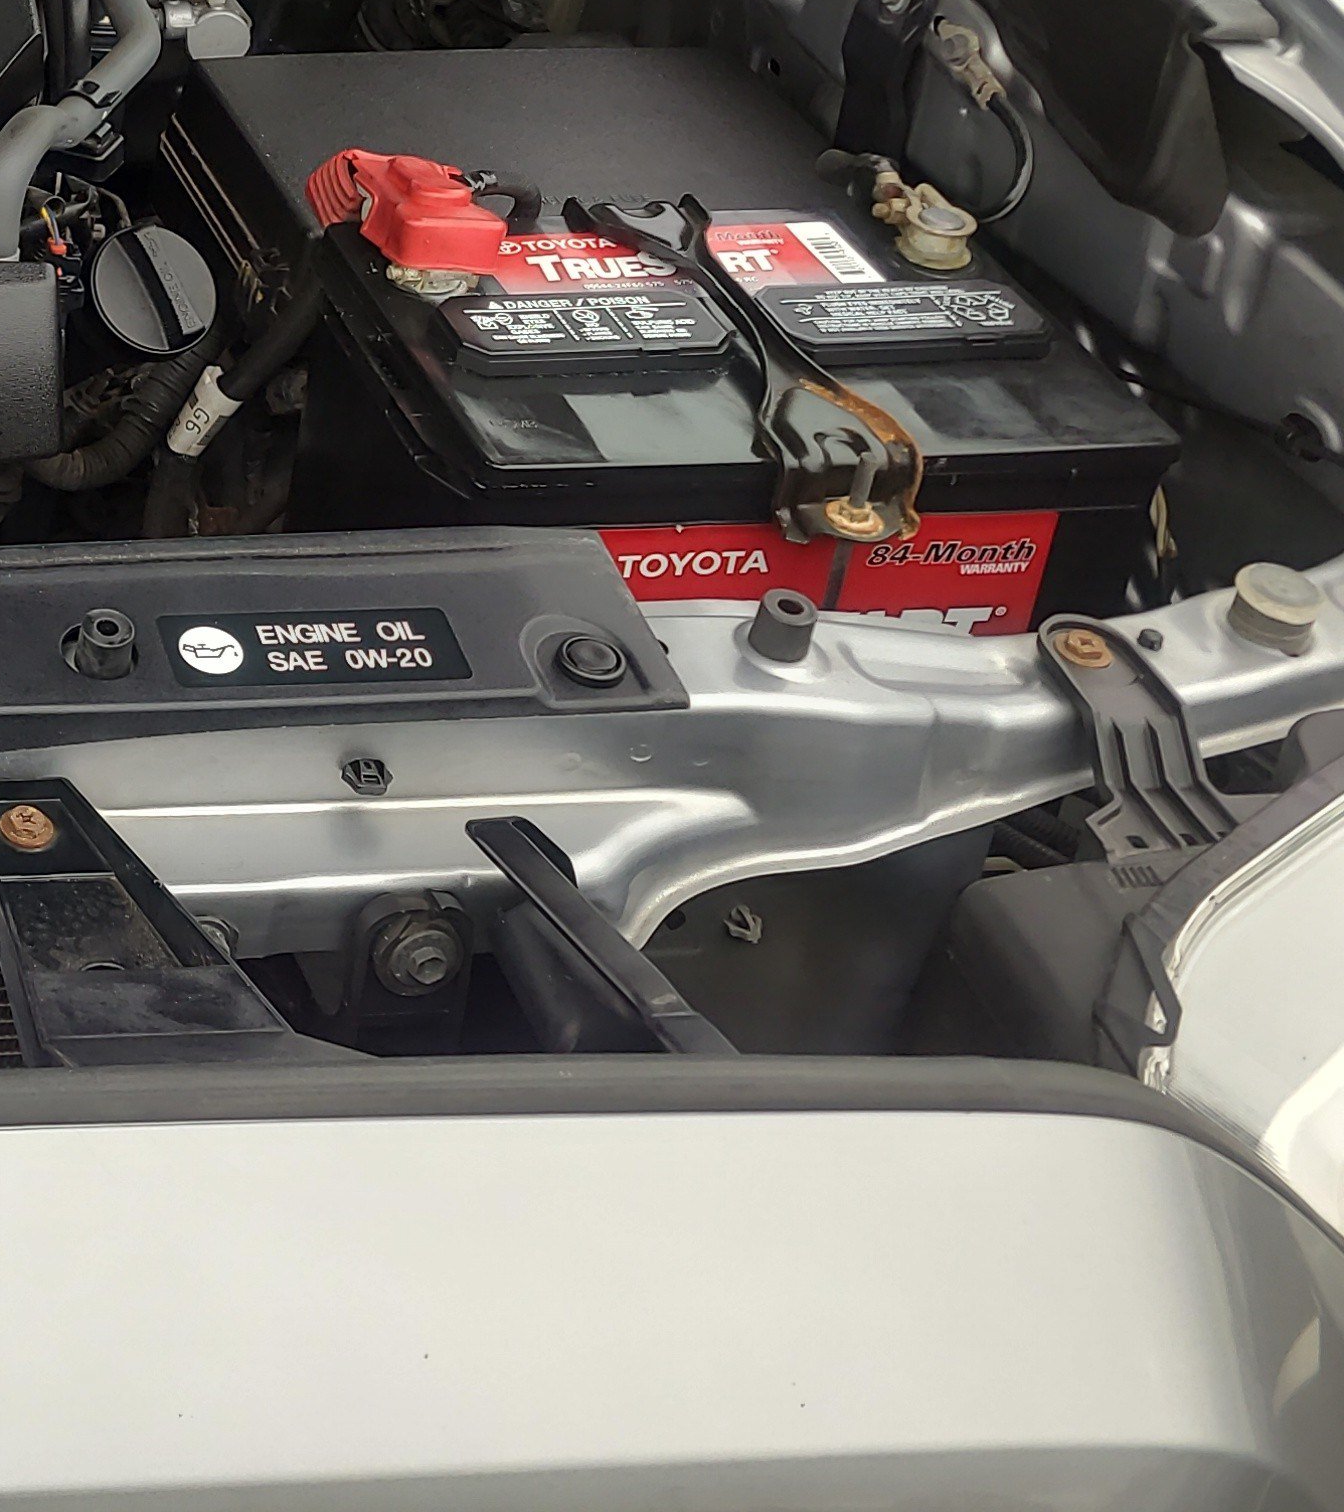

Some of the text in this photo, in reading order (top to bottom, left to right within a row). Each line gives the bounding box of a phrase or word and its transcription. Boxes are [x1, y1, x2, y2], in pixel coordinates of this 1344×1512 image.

[521, 236, 617, 253] TOYOTA
[504, 298, 571, 310] DANGER
[587, 296, 650, 306] POISON
[617, 538, 1037, 579] TOYOTA 84-Month
[959, 560, 1030, 576] WARRANTY
[255, 620, 426, 645] ENGINE OIL
[267, 646, 433, 672] SAE 0W-20
